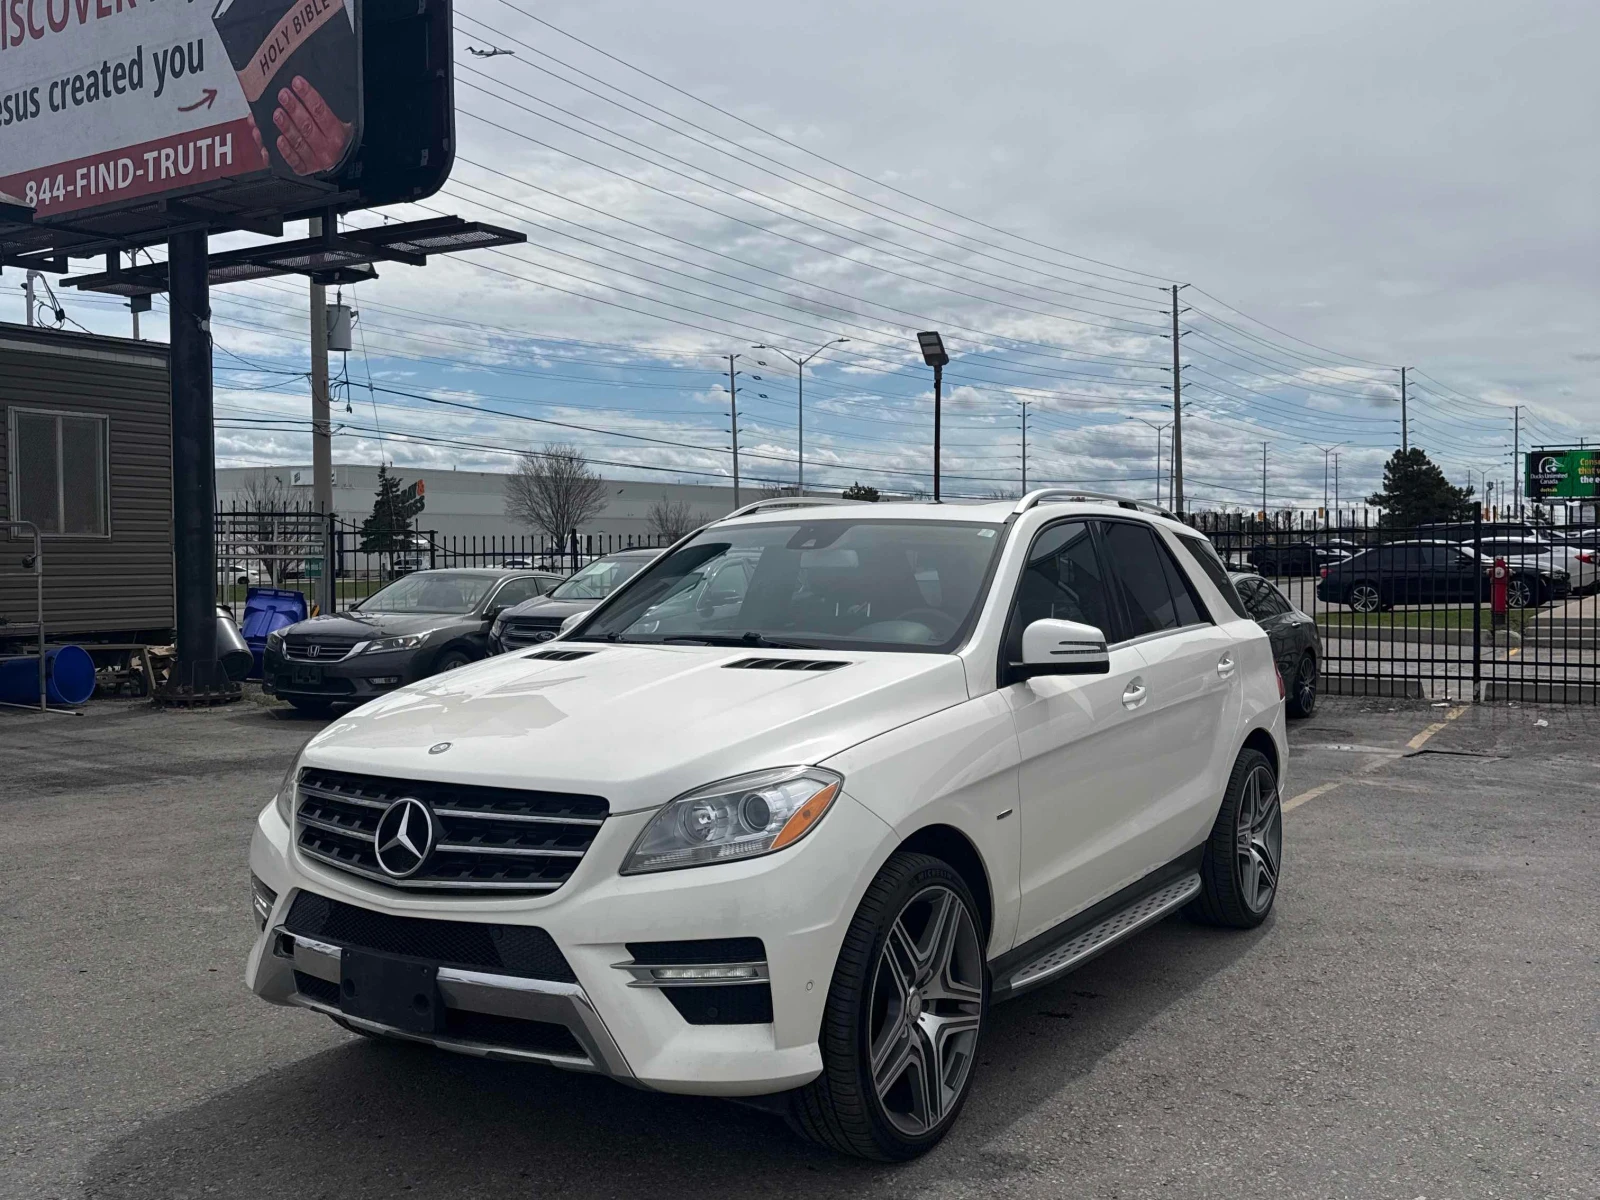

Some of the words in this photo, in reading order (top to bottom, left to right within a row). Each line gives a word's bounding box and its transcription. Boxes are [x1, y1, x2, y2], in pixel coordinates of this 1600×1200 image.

[0, 0, 137, 50] ISCOV
[260, 26, 290, 76] HOLY
[292, 0, 330, 35] BIBLE
[0, 87, 40, 127] sus
[49, 45, 144, 113] created
[153, 38, 204, 98] you
[25, 132, 232, 208] 844-FIND-TRUTH
[1580, 475, 1594, 484] the
